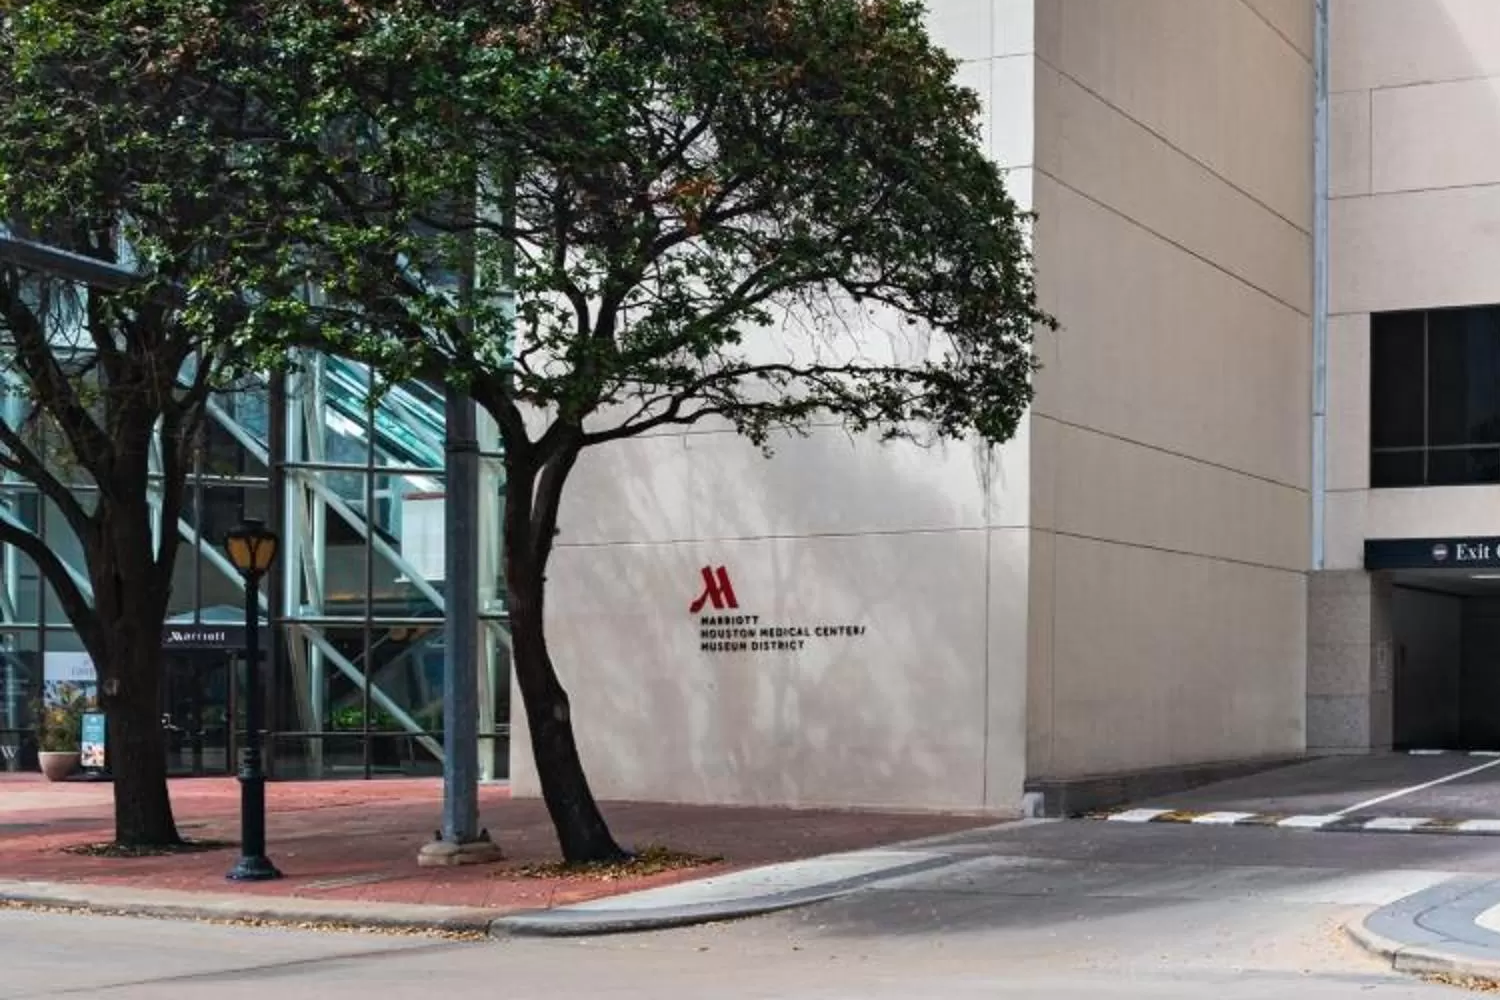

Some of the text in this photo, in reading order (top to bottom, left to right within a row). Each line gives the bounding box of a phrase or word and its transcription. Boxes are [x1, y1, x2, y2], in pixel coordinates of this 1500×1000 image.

[1456, 543, 1489, 560] Exit
[701, 615, 759, 625] MARRIOTT
[167, 631, 225, 642] Marriott
[701, 628, 756, 639] HOUSTON
[760, 626, 811, 638] MEDICAL
[701, 640, 805, 652] MUSEUM DISTRICT
